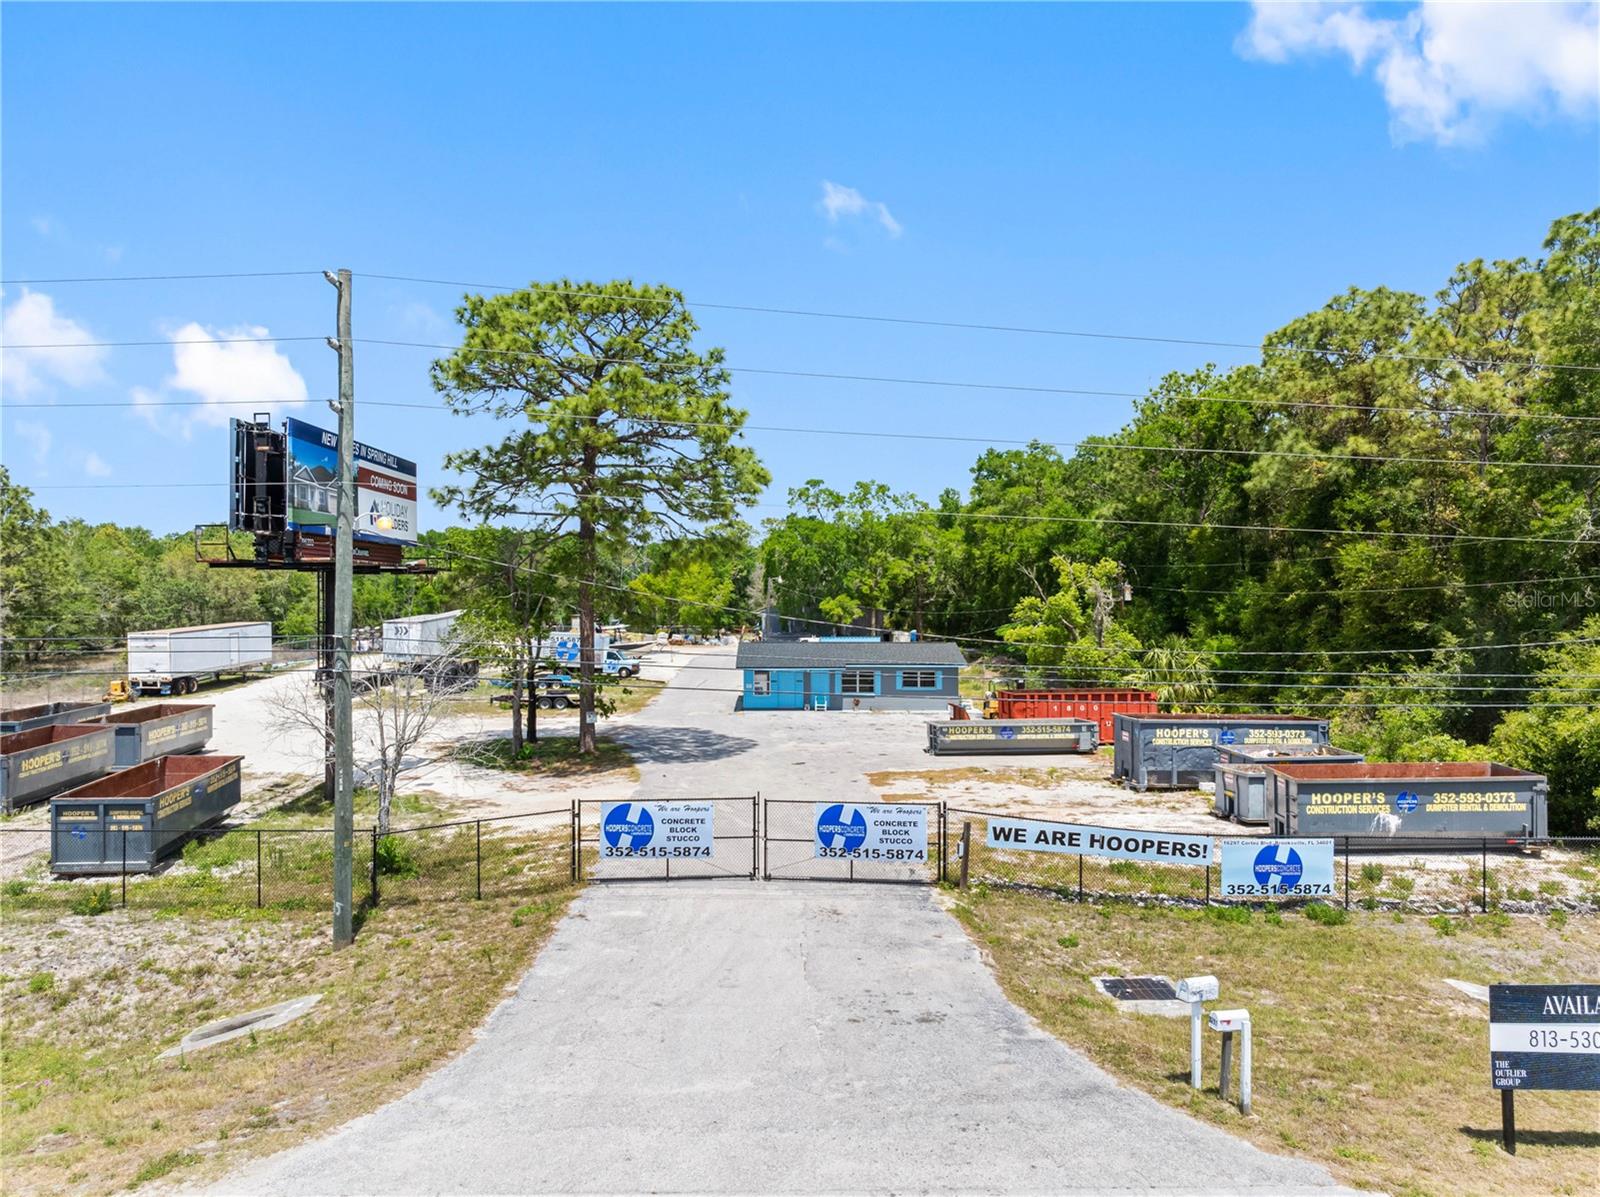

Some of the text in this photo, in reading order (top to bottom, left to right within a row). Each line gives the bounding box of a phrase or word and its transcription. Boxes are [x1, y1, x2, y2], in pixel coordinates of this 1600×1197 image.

[321, 431, 337, 448] NEW
[367, 448, 387, 465] SPRING
[387, 455, 398, 469] HILL
[370, 475, 408, 495] COMING SOON
[949, 727, 993, 735] HOOPER'S
[1156, 728, 1306, 738] HOOPER'S 352-593-0373
[22, 751, 61, 771] HOOPER'S
[159, 786, 191, 809] HOOPER'S
[1311, 792, 1386, 804] HOOPER'S
[1433, 791, 1516, 804] 352-593-0373
[1306, 804, 1357, 815] CONSTRUCTION
[1358, 804, 1391, 814] SERVICES
[1425, 803, 1458, 812] DUMPSTER
[1459, 803, 1482, 812] RENTAL
[1489, 803, 1527, 811] DEMOLITION
[669, 826, 697, 834] BLOCK
[992, 826, 1208, 859] WE ARE HOOPERS!
[605, 846, 711, 857] 352-515-5874
[819, 847, 924, 860] 352-515-5874
[1227, 884, 1331, 895] 352-515-5874
[1529, 1030, 1600, 1049] 813-530
[1495, 1060, 1510, 1069] THE
[1495, 1069, 1527, 1077] OUTLIER
[1495, 1078, 1521, 1086] GROUP
